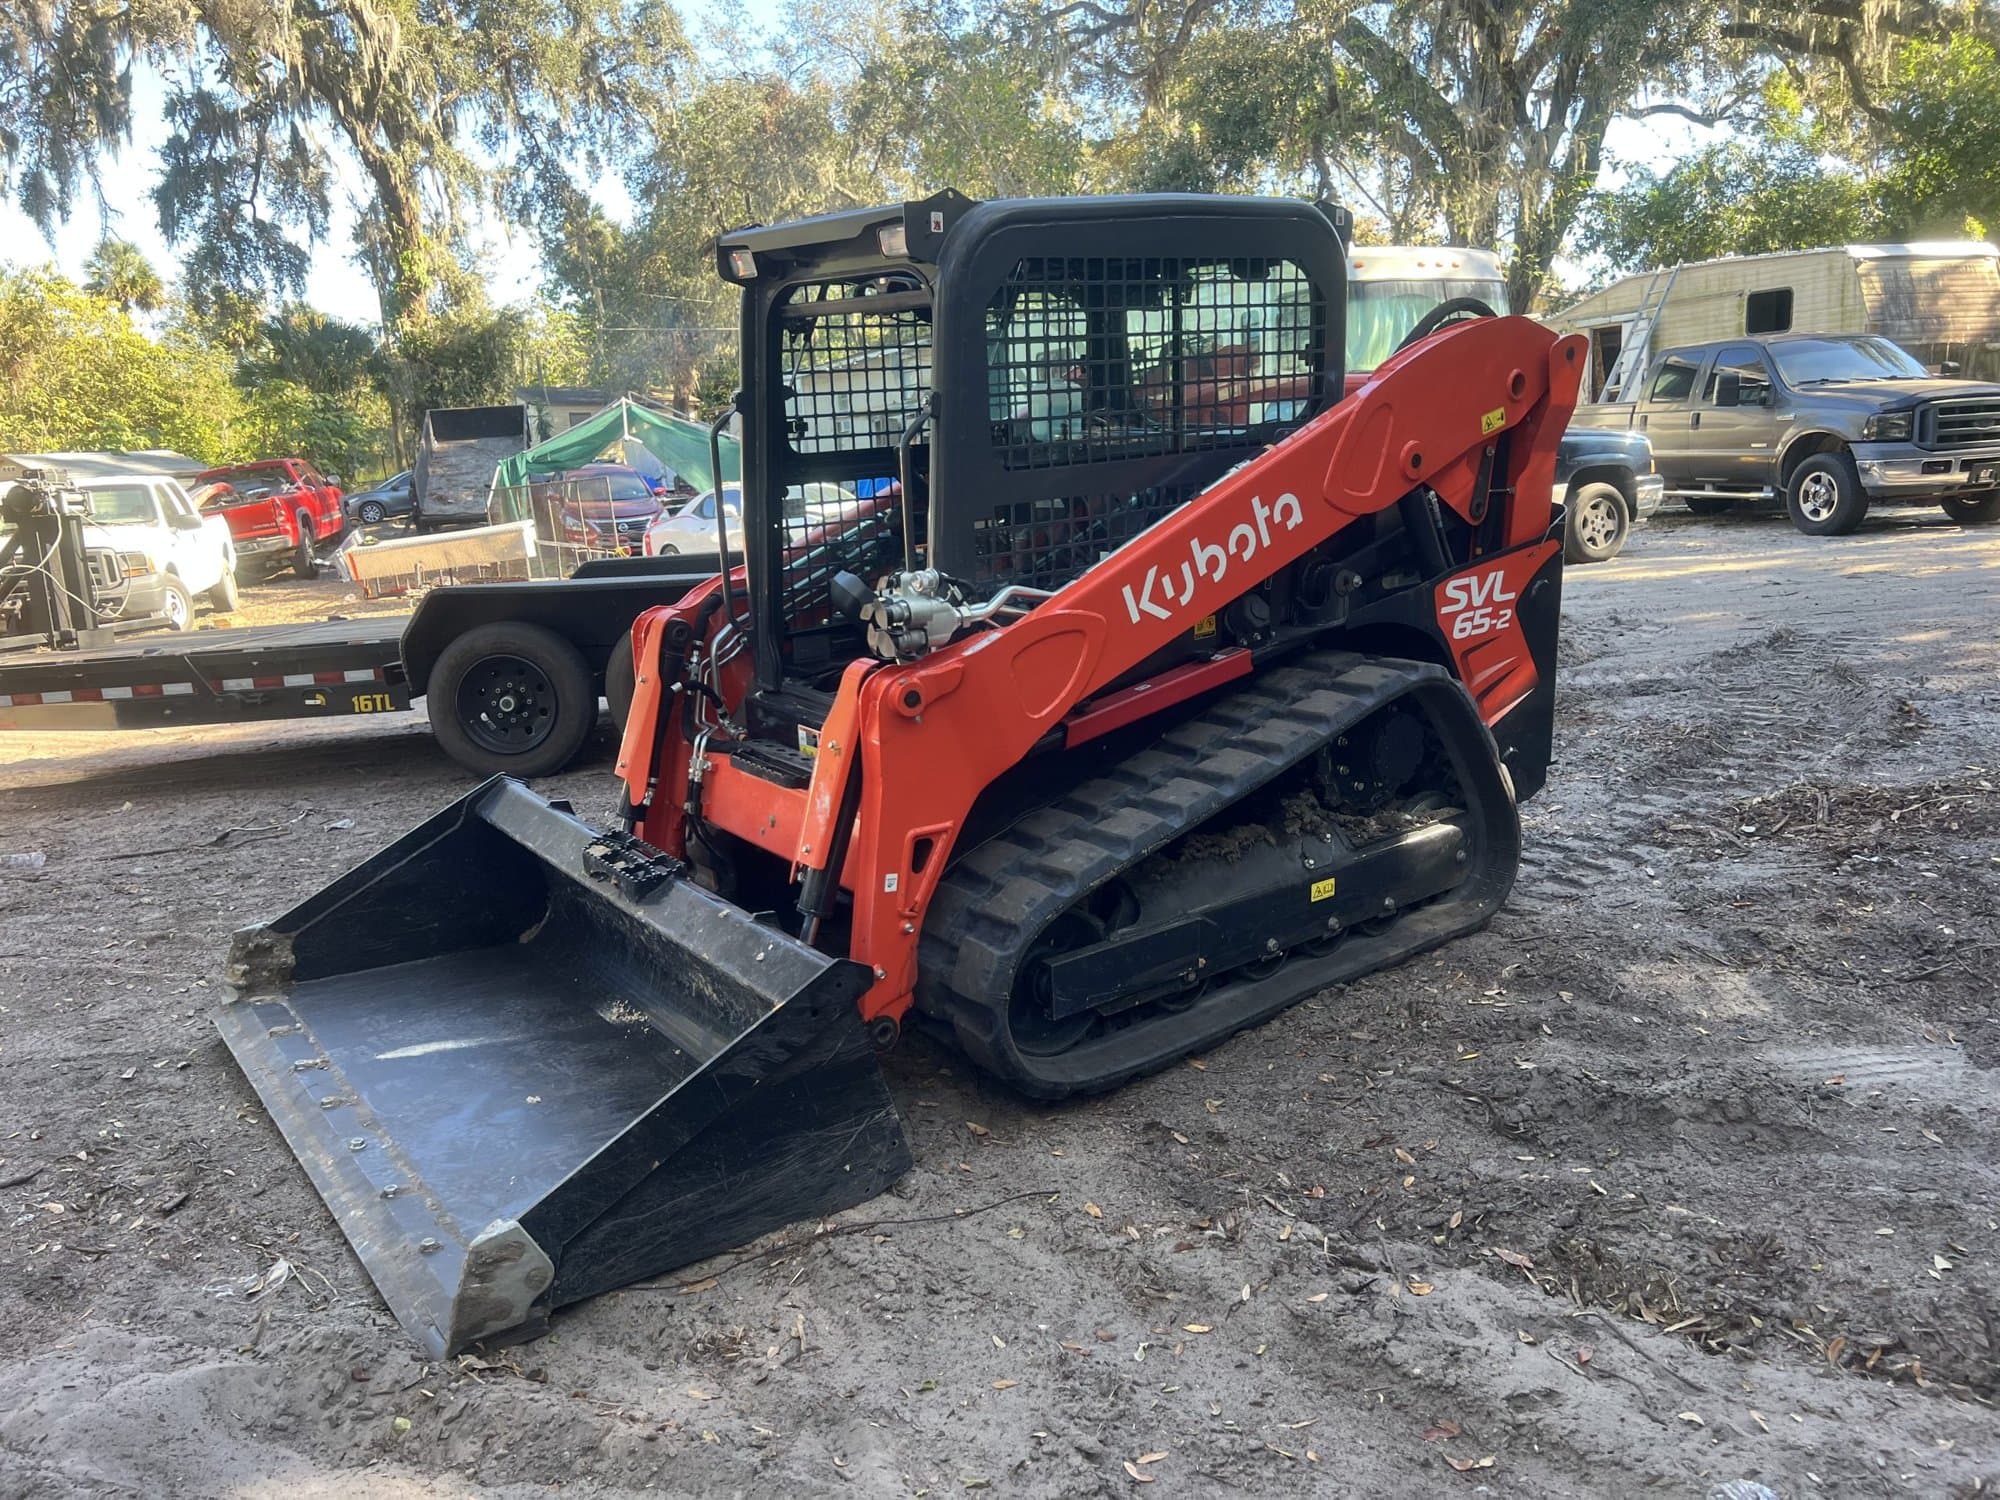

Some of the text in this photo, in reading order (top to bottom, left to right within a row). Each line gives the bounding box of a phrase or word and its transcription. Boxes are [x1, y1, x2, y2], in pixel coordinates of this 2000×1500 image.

[1121, 492, 1303, 624] Kubota
[1440, 570, 1516, 614] SVL
[1452, 606, 1512, 640] 65-2
[351, 693, 395, 713] 16TL
